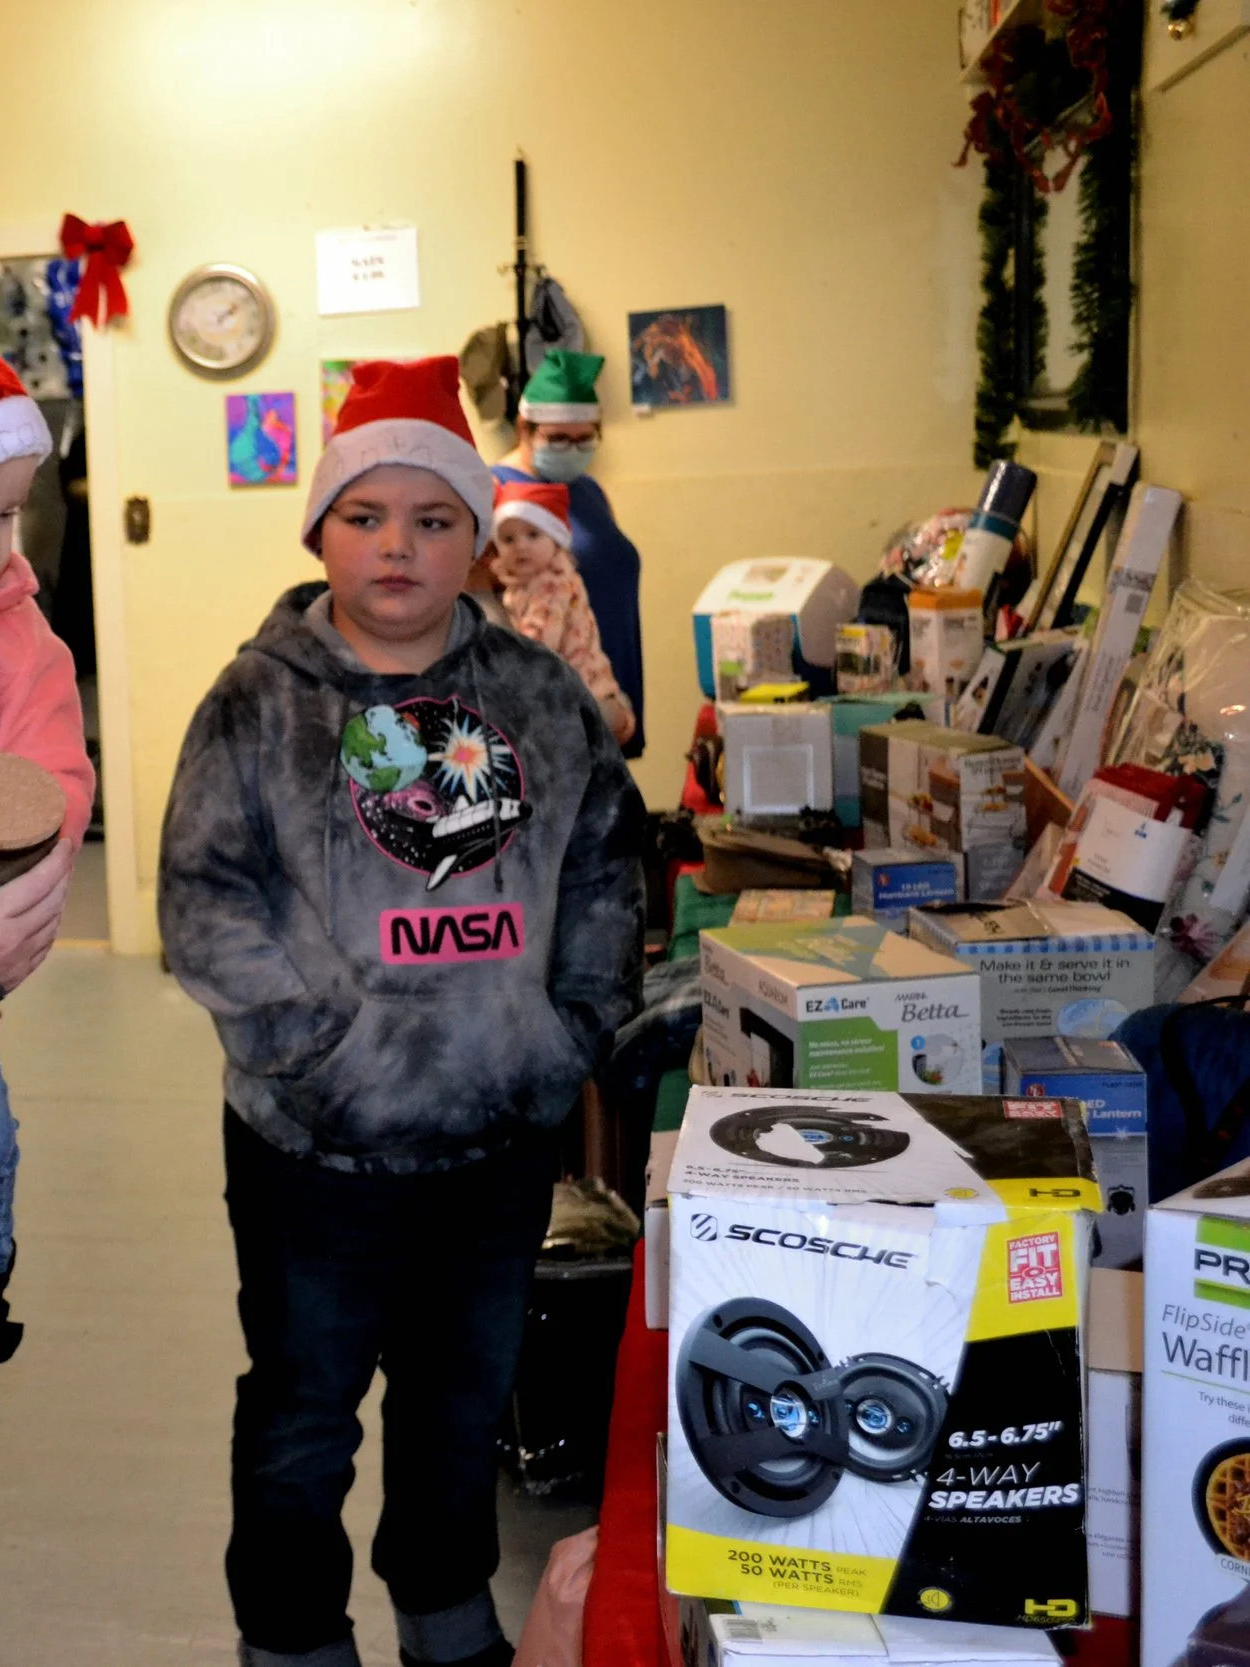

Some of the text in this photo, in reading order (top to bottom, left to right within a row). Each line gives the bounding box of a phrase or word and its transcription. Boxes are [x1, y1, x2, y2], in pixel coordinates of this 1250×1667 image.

[390, 911, 519, 956] NASA
[980, 958, 1130, 971] Make it & serve it in
[998, 971, 1111, 984] the same bowl
[806, 998, 867, 1013] EZ Care
[901, 1003, 970, 1023] Betta
[731, 1091, 872, 1102] SCOSCHE
[1092, 1108, 1141, 1119] Lantern
[725, 1224, 915, 1269] SCOSCHE
[1009, 1234, 1055, 1250] FACTORY
[1010, 1243, 1057, 1272] FIT
[1010, 1272, 1058, 1291] EASY
[1010, 1286, 1061, 1301] INSTALL
[1198, 1391, 1215, 1406] Try
[1217, 1395, 1245, 1412] these
[936, 1461, 1041, 1486] 4-WAY
[928, 1482, 1081, 1510] SPEAKERS
[959, 1515, 1022, 1524] ALTAVOCES
[728, 1549, 867, 1577] 200 WATTS PEAK
[740, 1563, 863, 1589] 50 WATTS RMS
[1025, 1599, 1077, 1617] HD
